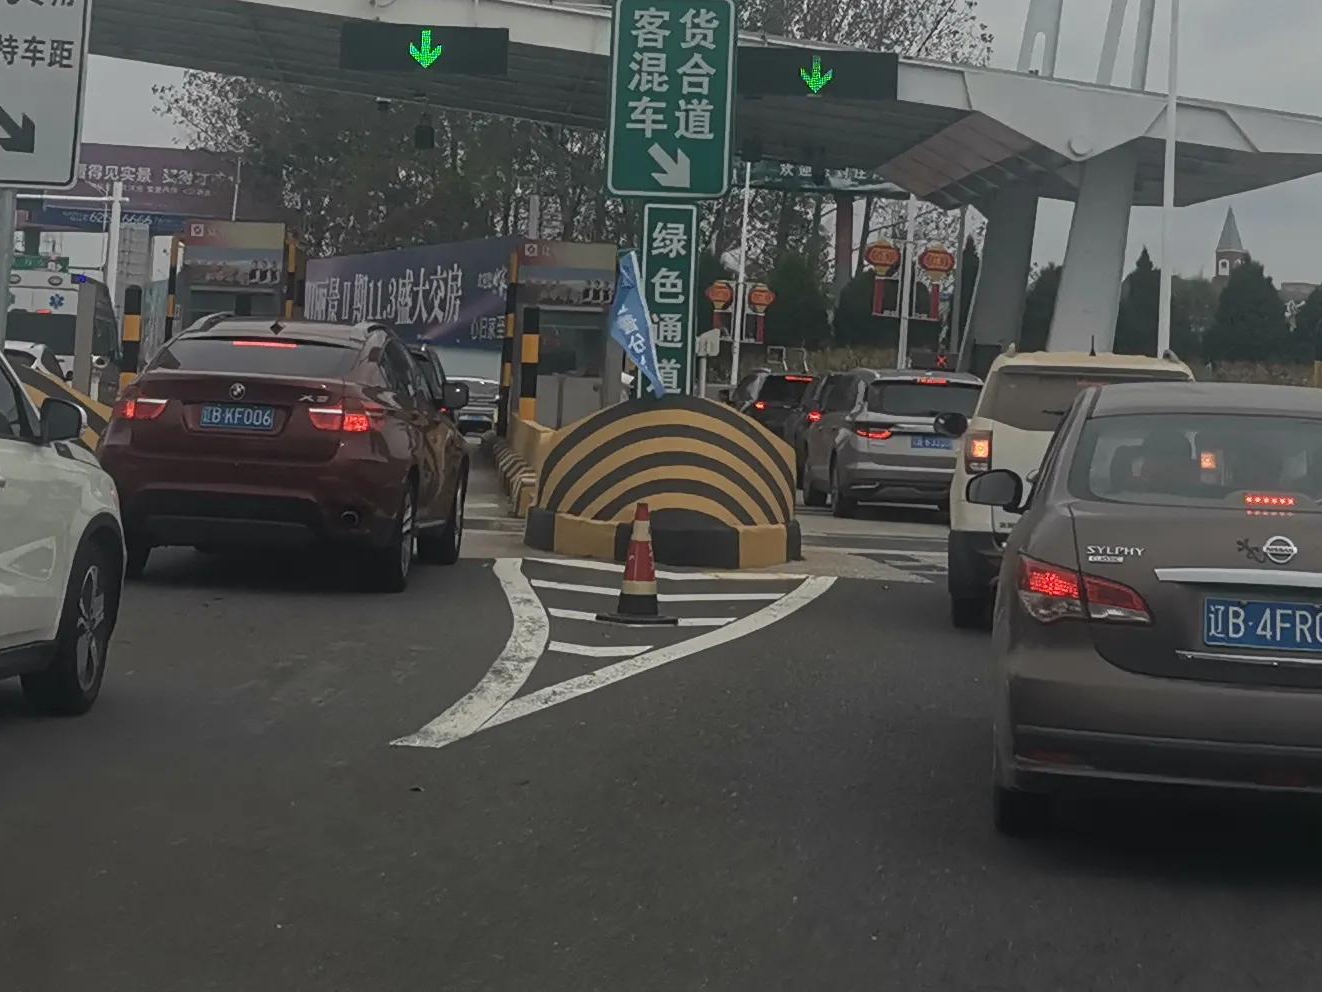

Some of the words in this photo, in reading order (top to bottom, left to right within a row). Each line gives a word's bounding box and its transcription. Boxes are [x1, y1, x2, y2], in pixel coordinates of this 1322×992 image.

[646, 222, 688, 394] 绿色通道
[1086, 545, 1145, 556] SYLPHY
